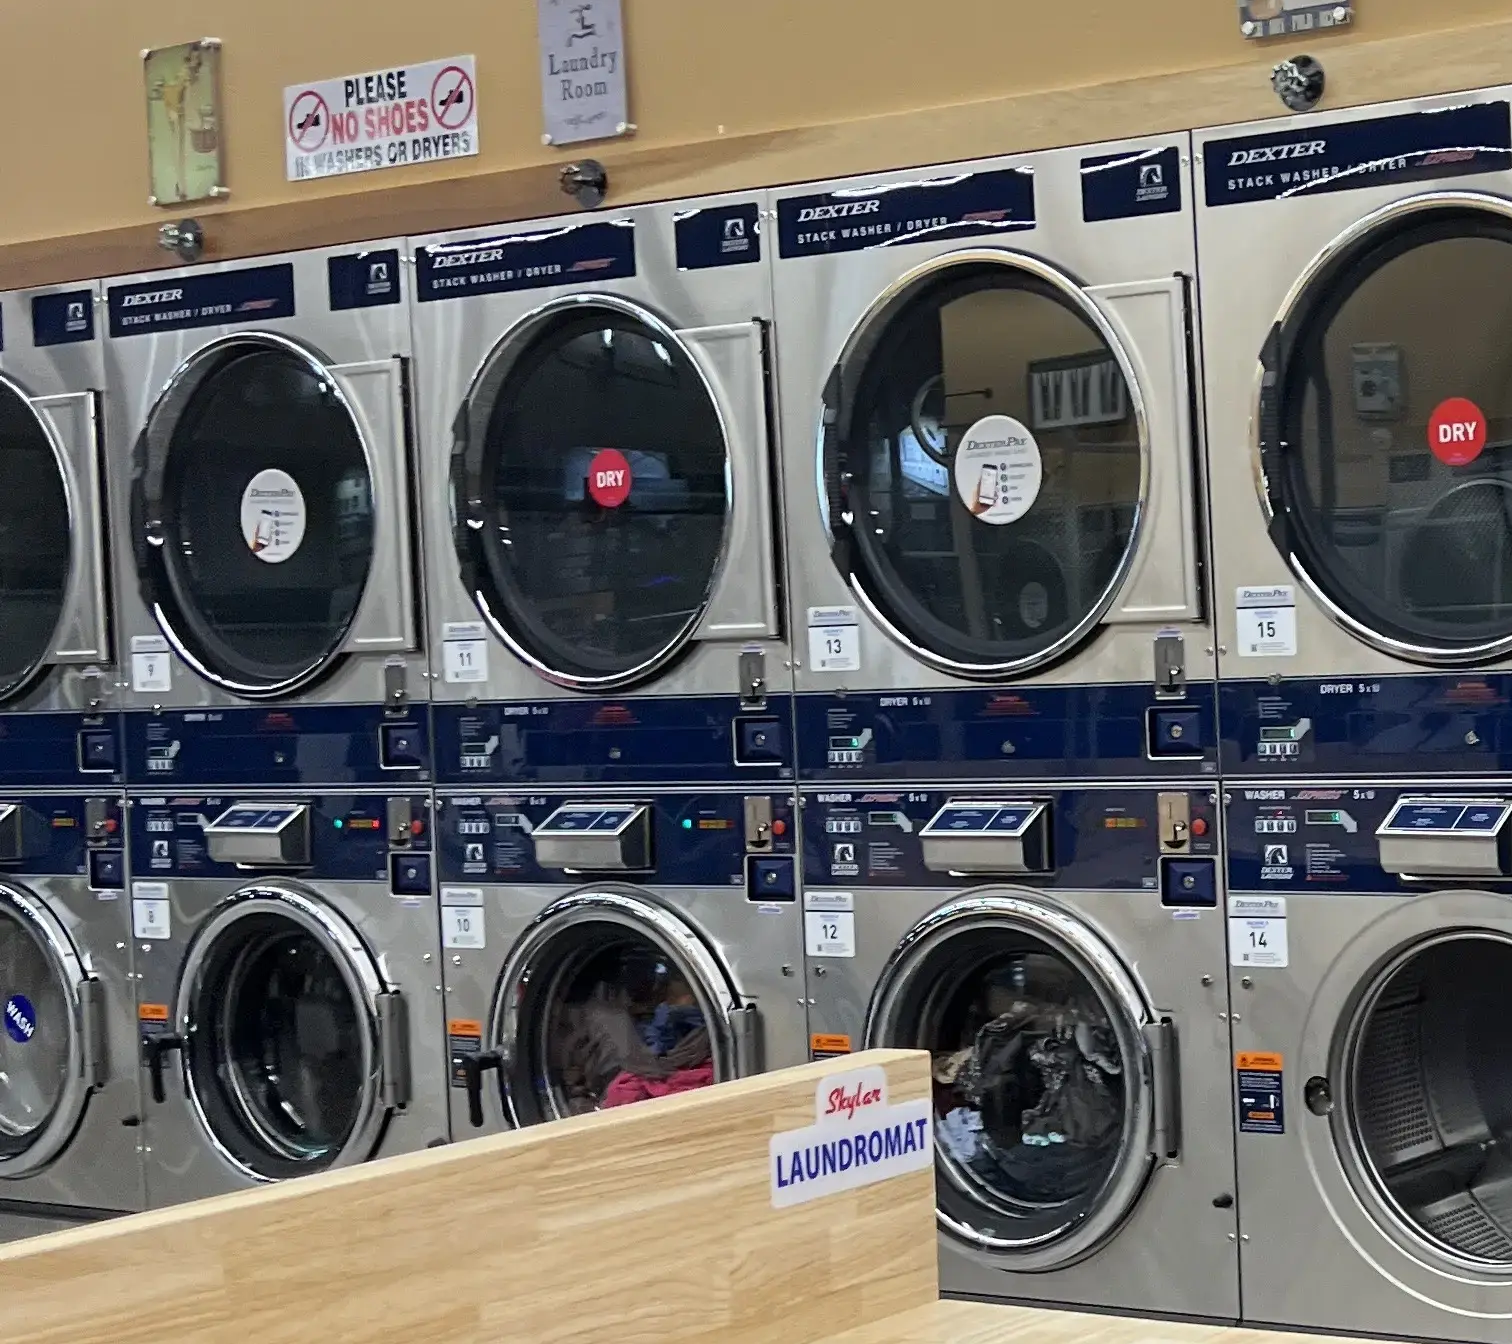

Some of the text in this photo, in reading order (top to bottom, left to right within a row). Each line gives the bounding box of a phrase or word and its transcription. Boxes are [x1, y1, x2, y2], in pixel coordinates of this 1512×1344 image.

[548, 46, 617, 76] Laundry
[344, 70, 407, 107] PLEASE
[560, 79, 608, 101] Room
[332, 98, 429, 145] NO SHOES
[388, 142, 407, 164] OR
[412, 131, 471, 161] DRYERS
[1227, 140, 1326, 166] DEXTER
[1228, 174, 1274, 190] STACK
[1281, 166, 1339, 185] WASHER
[797, 200, 880, 223] DEXTER
[798, 230, 836, 245] STACK
[842, 223, 892, 238] WASHER
[907, 216, 948, 230] DRYER
[432, 248, 504, 269] DEXTER
[432, 276, 466, 290] STACK
[470, 269, 514, 285] WASHER
[122, 288, 183, 307] DEXTER
[1438, 421, 1477, 443] DRY
[596, 469, 626, 489] DRY
[1257, 621, 1276, 638] 15
[826, 639, 842, 654] 13
[459, 652, 472, 667] 11
[1320, 684, 1353, 694] DRYER
[1244, 790, 1285, 800] WASHER
[457, 918, 469, 932] 10
[823, 924, 838, 939] 12
[1249, 931, 1268, 948] 14
[6, 1000, 35, 1038] WASH
[825, 1082, 881, 1120] Skylar
[777, 1118, 927, 1188] LAUNDROMAT
